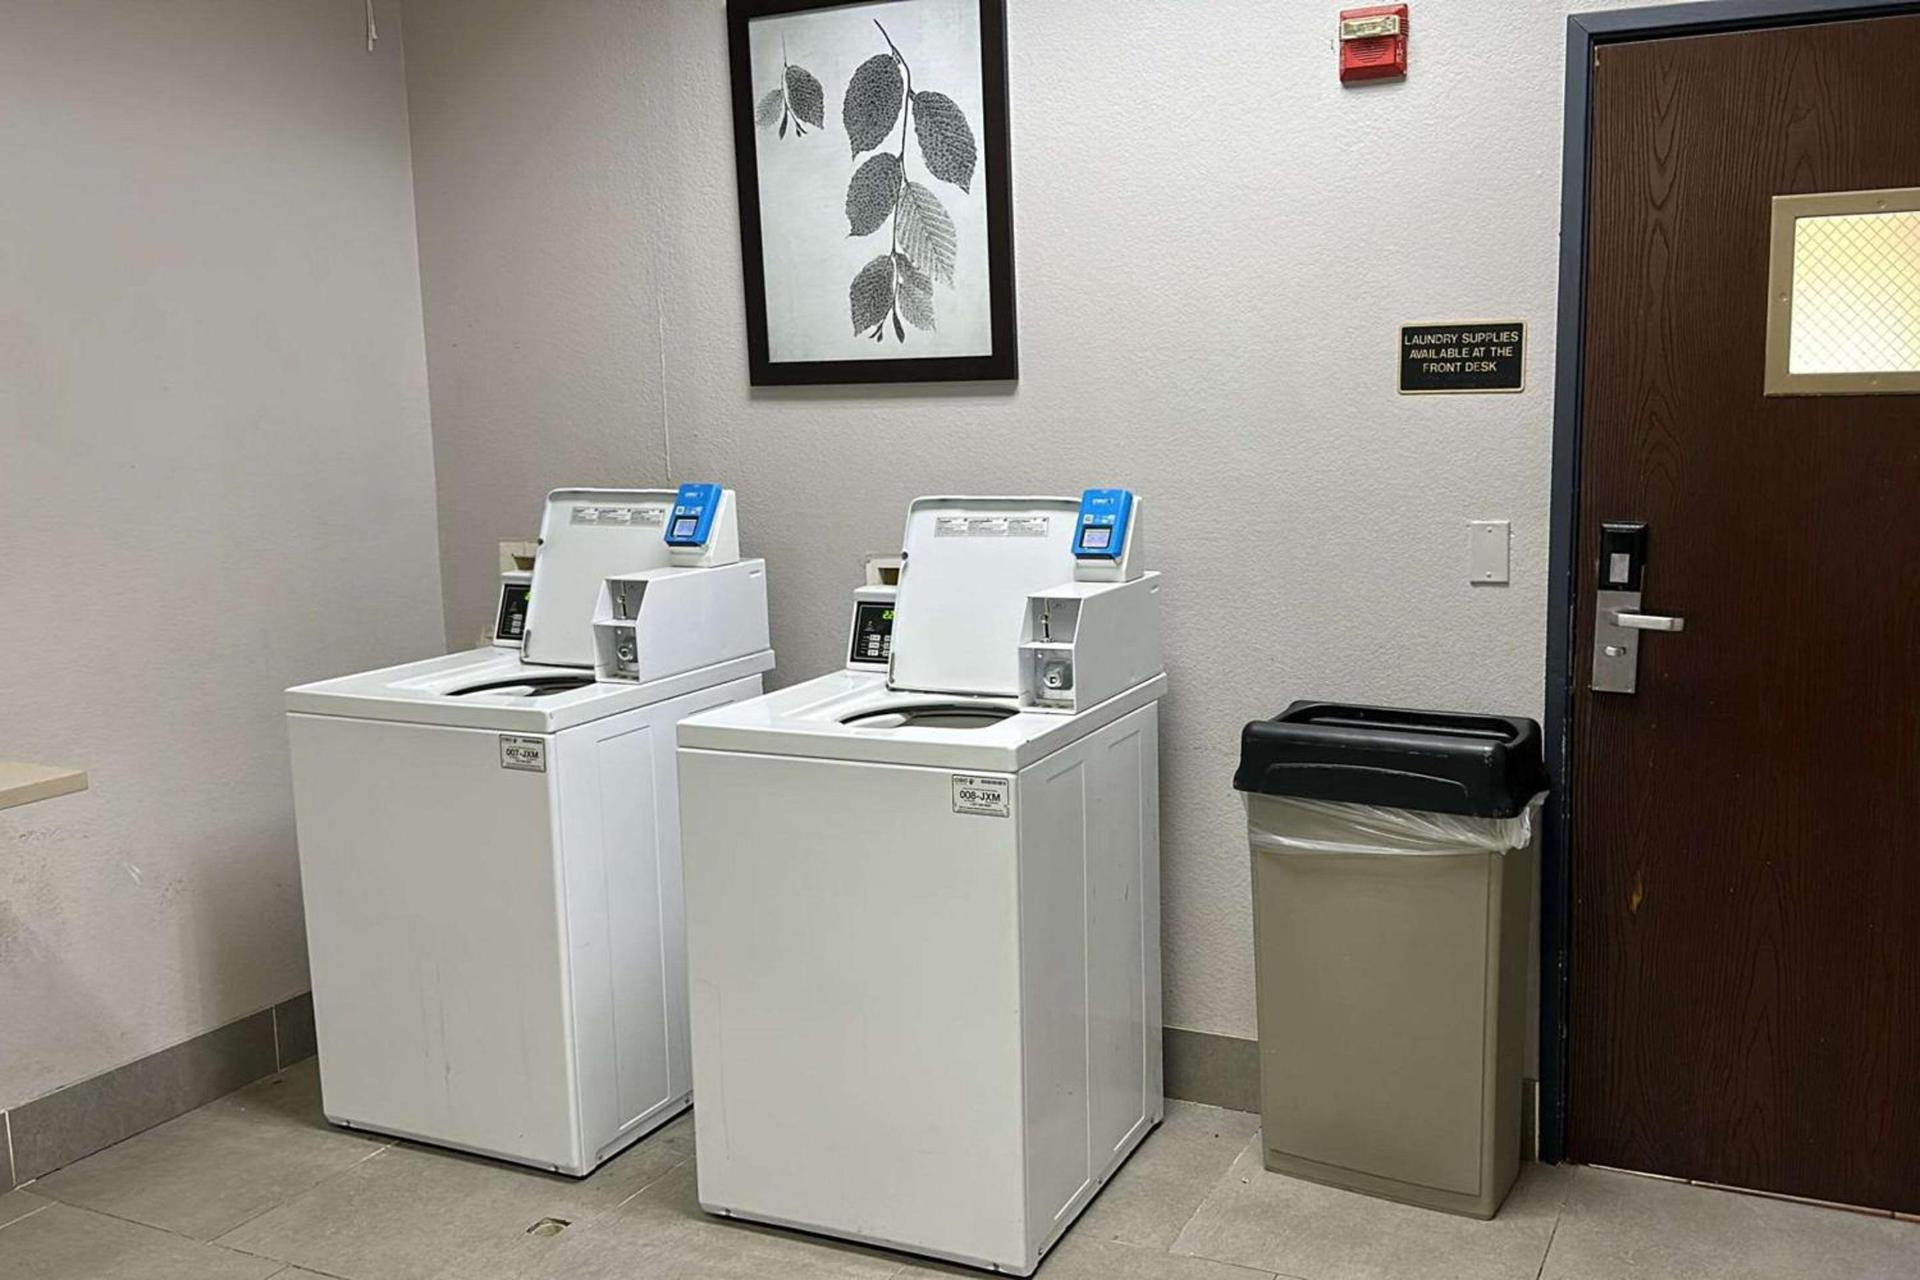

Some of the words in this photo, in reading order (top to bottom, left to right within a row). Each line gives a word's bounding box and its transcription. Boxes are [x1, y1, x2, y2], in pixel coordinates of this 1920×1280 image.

[1404, 333, 1458, 346] LAUNDRY
[1462, 331, 1519, 343] SUPPLIES
[1409, 347, 1470, 359] AVAILABLE
[1472, 347, 1485, 358] AT
[1490, 346, 1513, 357] THE
[1423, 362, 1462, 373] FRONT
[1465, 361, 1497, 372] DESK
[960, 790, 1001, 801] 008-JXM
